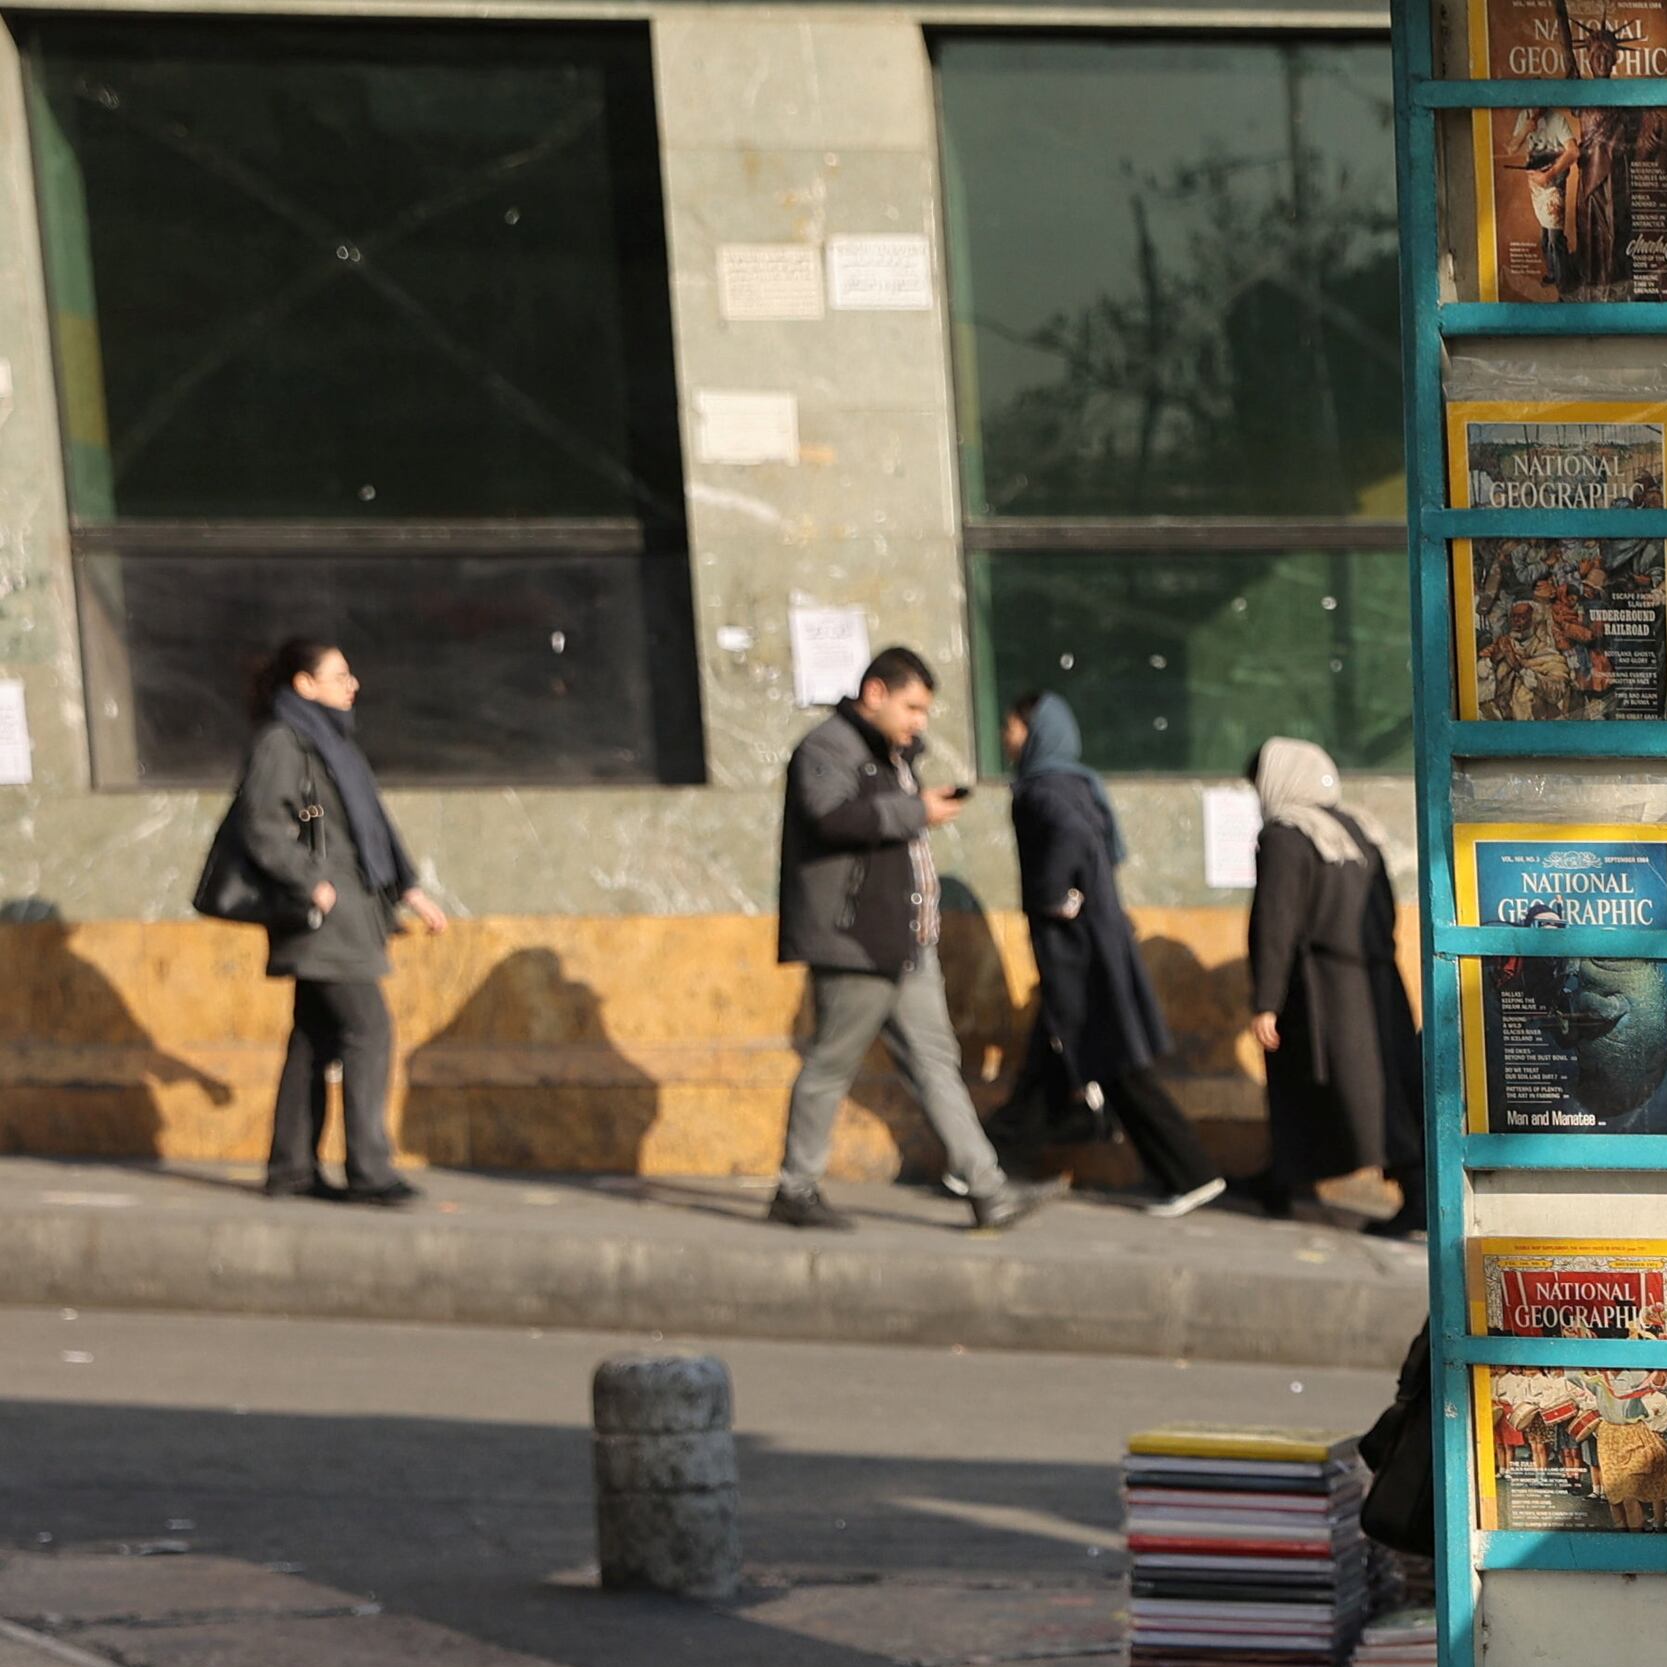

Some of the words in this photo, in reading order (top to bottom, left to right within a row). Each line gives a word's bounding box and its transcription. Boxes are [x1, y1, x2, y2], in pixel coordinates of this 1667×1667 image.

[1534, 19, 1648, 40] NAIONAL
[1509, 47, 1667, 76] GEORPHIC
[1514, 455, 1625, 477] NATIONAL
[1589, 610, 1655, 622] UNDERGROUND
[1604, 624, 1650, 636] RAILROAD
[1521, 873, 1633, 894] NATIONAL
[1498, 899, 1653, 925] GERAPHIC
[1507, 1110, 1528, 1126] Man
[1532, 1110, 1548, 1126] and
[1552, 1110, 1596, 1126] Manatee
[1536, 1283, 1636, 1301] NATIONAL
